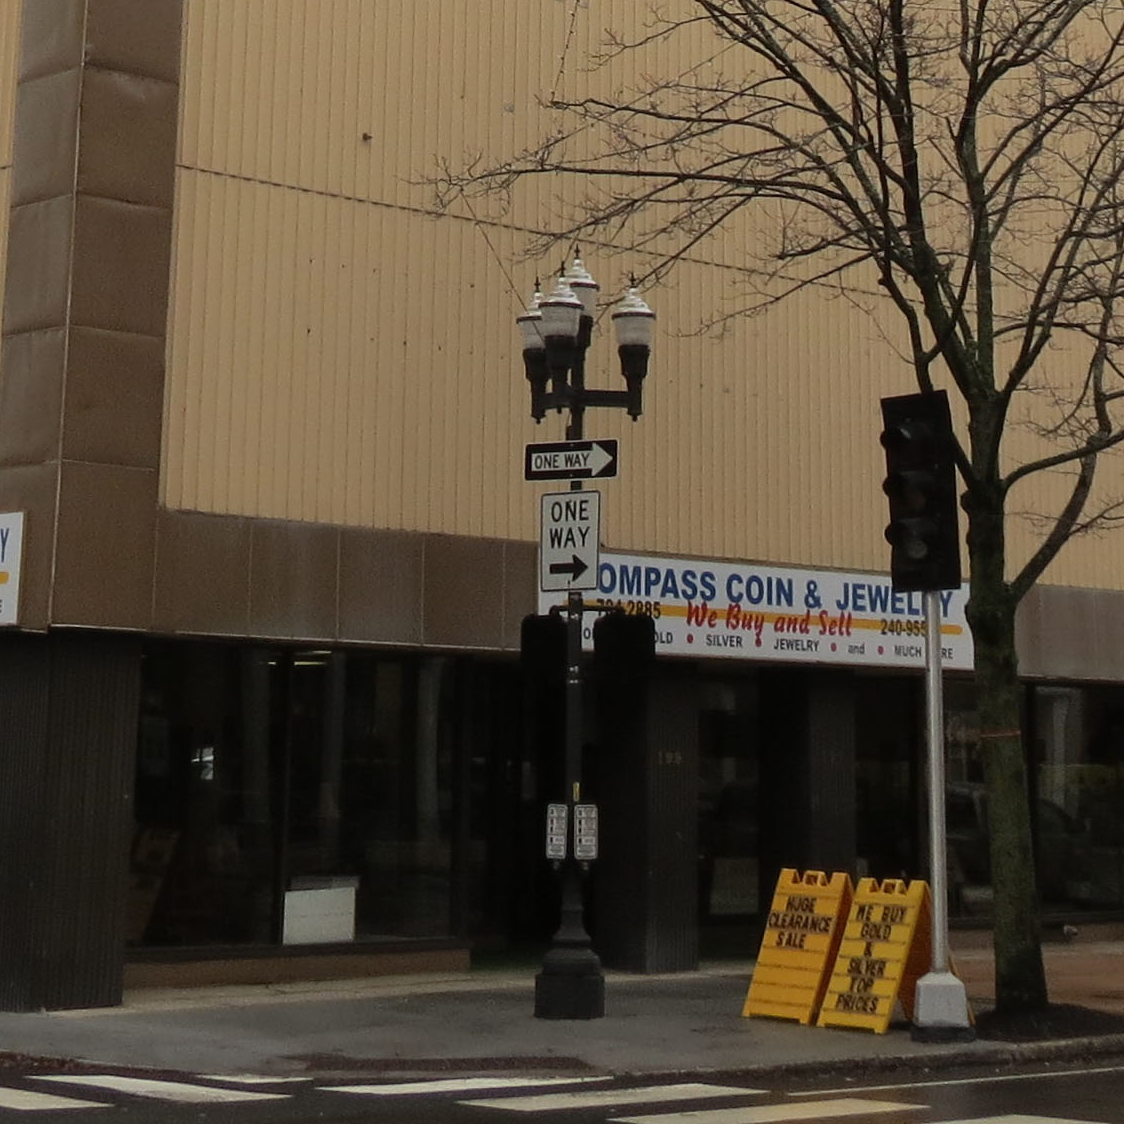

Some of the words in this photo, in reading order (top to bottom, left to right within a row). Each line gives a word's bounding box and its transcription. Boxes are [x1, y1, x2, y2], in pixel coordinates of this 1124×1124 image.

[534, 454, 560, 470] ONE
[564, 452, 590, 468] WAY
[551, 500, 590, 522] ONE
[549, 526, 590, 549] WAY
[598, 563, 716, 601] OMPASS
[726, 573, 793, 607] COIN
[804, 579, 822, 609] &
[836, 582, 953, 618] JEWELY
[686, 599, 718, 628] We
[726, 603, 764, 636] Buy
[774, 609, 810, 634] and
[819, 610, 853, 636] Sell
[881, 619, 928, 636] 240-955
[654, 632, 673, 644] OLD
[706, 634, 743, 648] SILVER
[774, 638, 820, 652] JEWELRY
[848, 643, 865, 655] and
[894, 645, 922, 658] MUCH
[786, 896, 817, 914] HUGE
[768, 913, 833, 933] CLEARANCE
[881, 906, 907, 923] BUY
[776, 932, 807, 949] SALE
[861, 923, 892, 940] GOLD
[847, 959, 886, 977] SILVER
[850, 977, 875, 993] TOP
[835, 995, 879, 1012] PRICES
